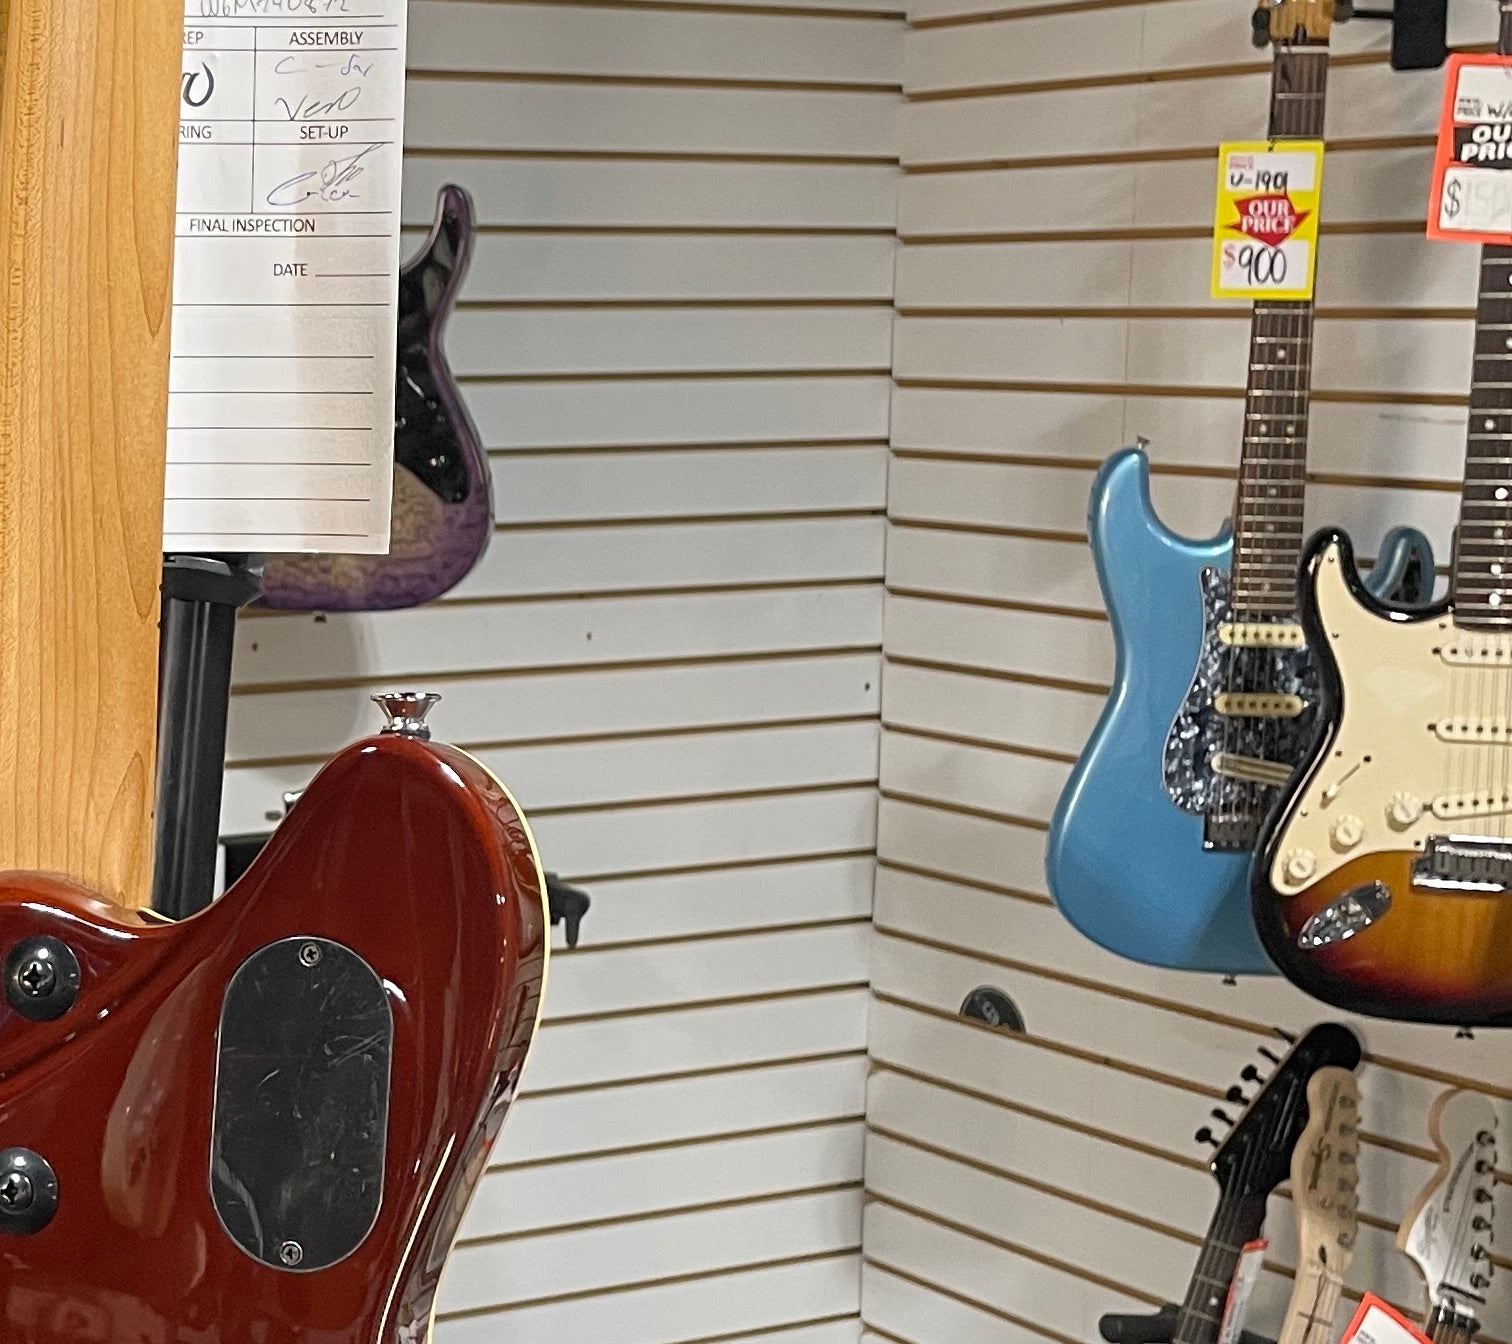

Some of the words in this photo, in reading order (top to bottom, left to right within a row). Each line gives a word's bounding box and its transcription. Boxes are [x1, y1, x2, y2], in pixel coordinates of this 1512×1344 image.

[288, 31, 364, 46] ASSEMBLY
[299, 125, 349, 140] SET-UP
[1472, 124, 1512, 144] OU
[1248, 199, 1289, 217] OUR
[189, 218, 231, 233] FINAL
[231, 218, 316, 234] INSPECTION
[1241, 215, 1297, 234] PRICE
[273, 263, 309, 277] DATE
[1223, 244, 1288, 287] $900
